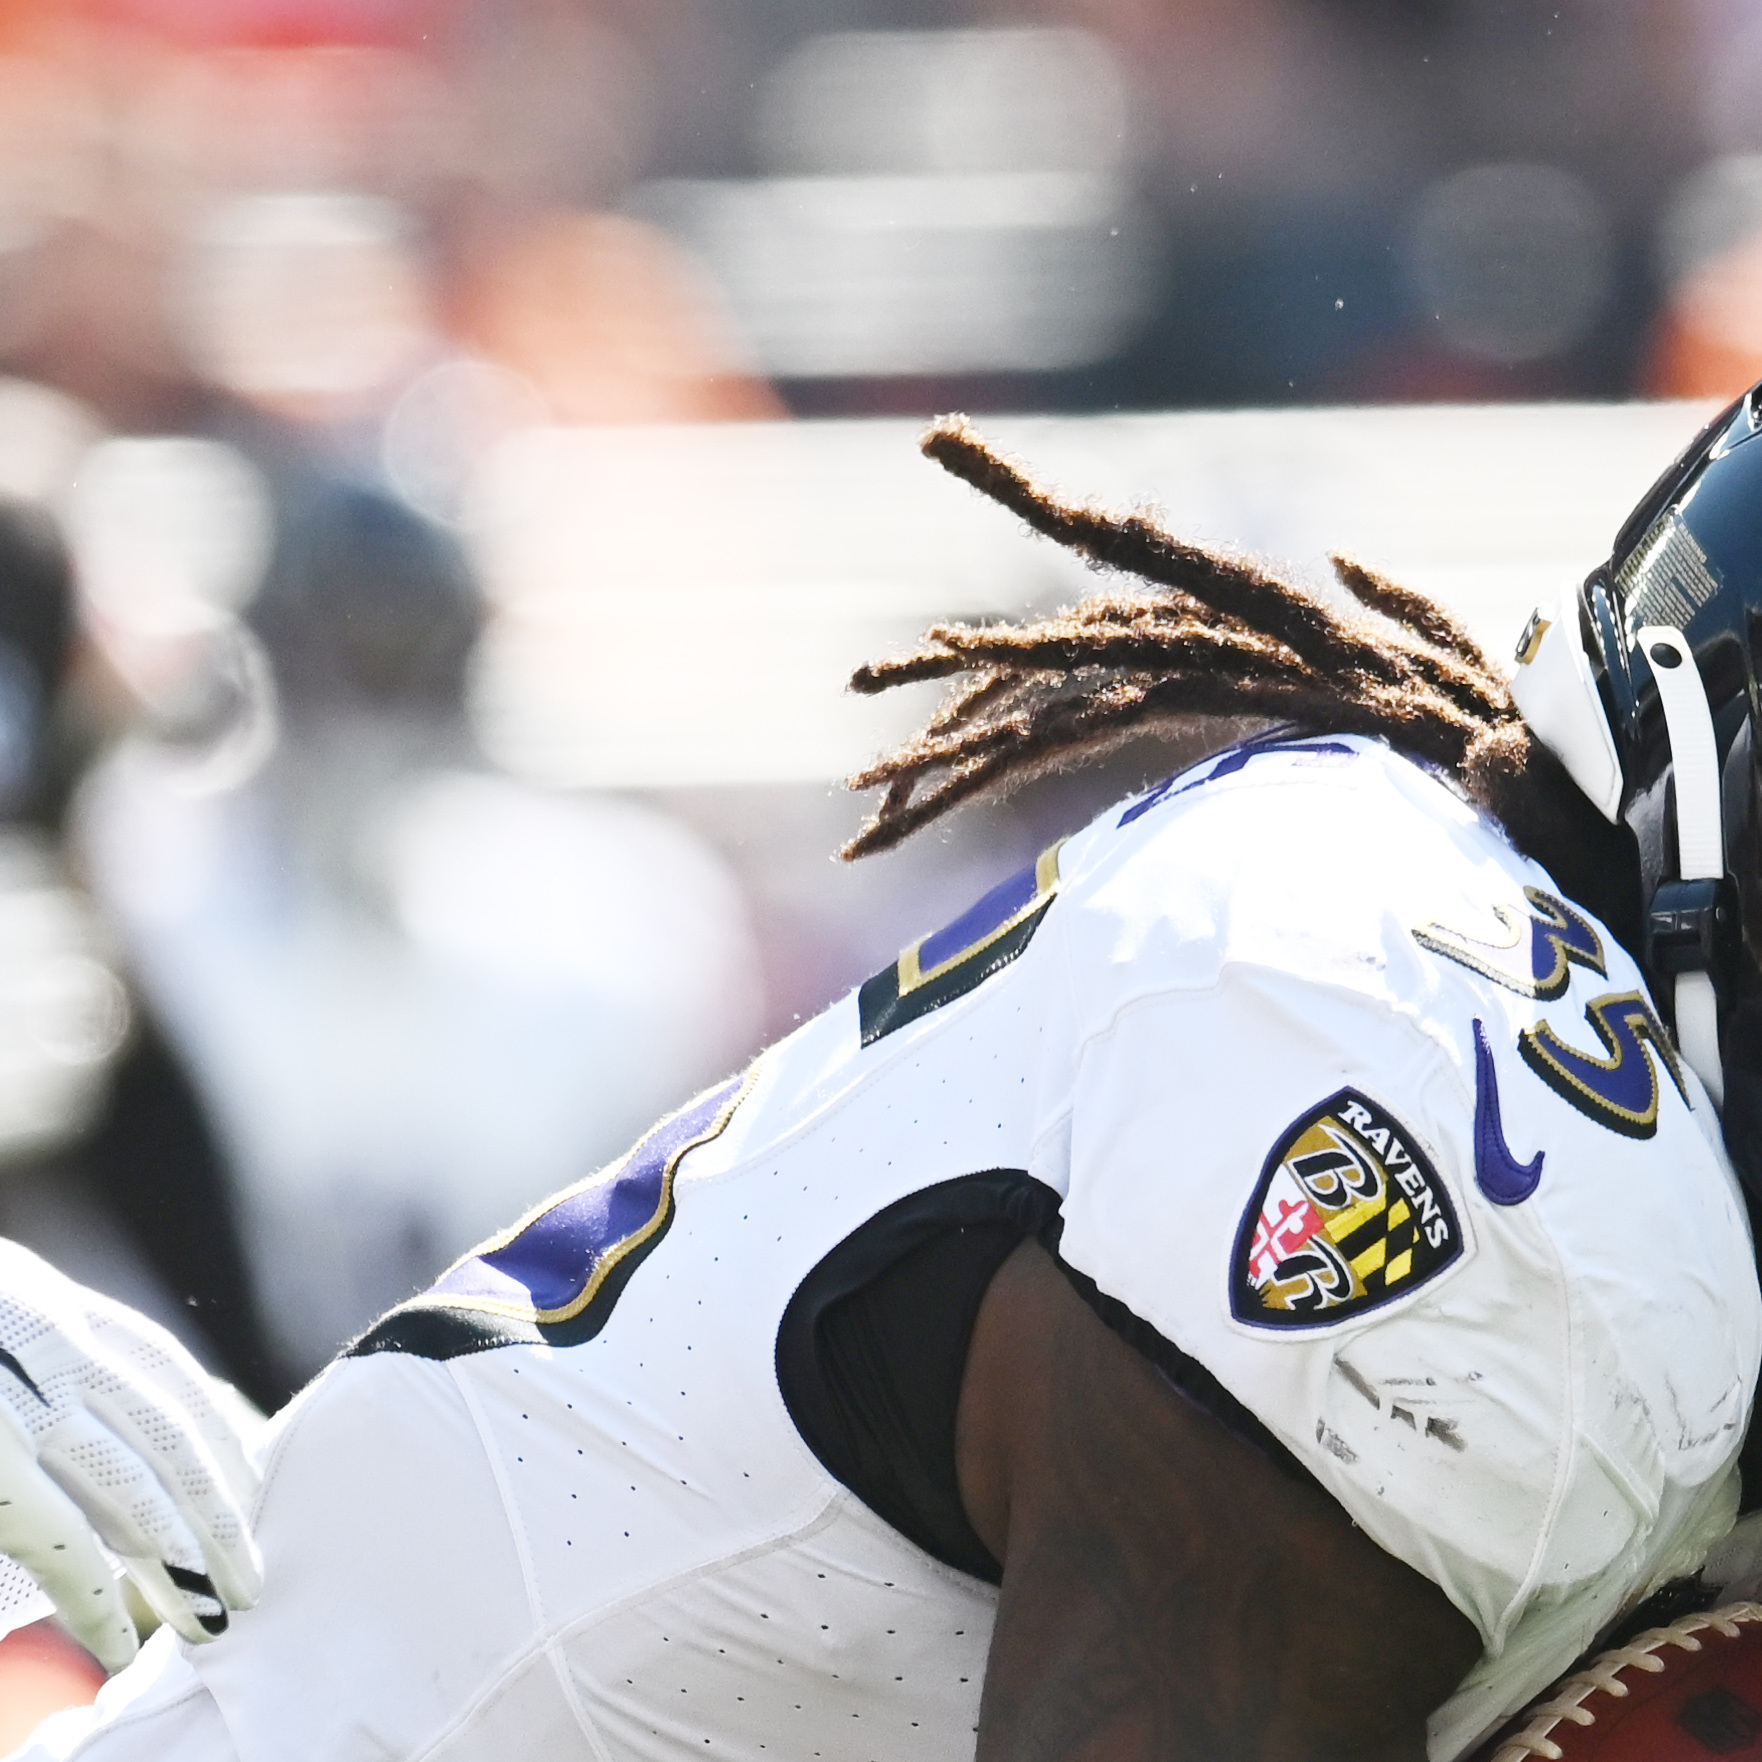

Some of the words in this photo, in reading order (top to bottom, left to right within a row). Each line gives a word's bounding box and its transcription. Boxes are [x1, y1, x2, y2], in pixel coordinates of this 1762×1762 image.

[1411, 885, 1693, 1141] 35
[1286, 1122, 1385, 1211] B
[1337, 1099, 1450, 1250] RAVENS
